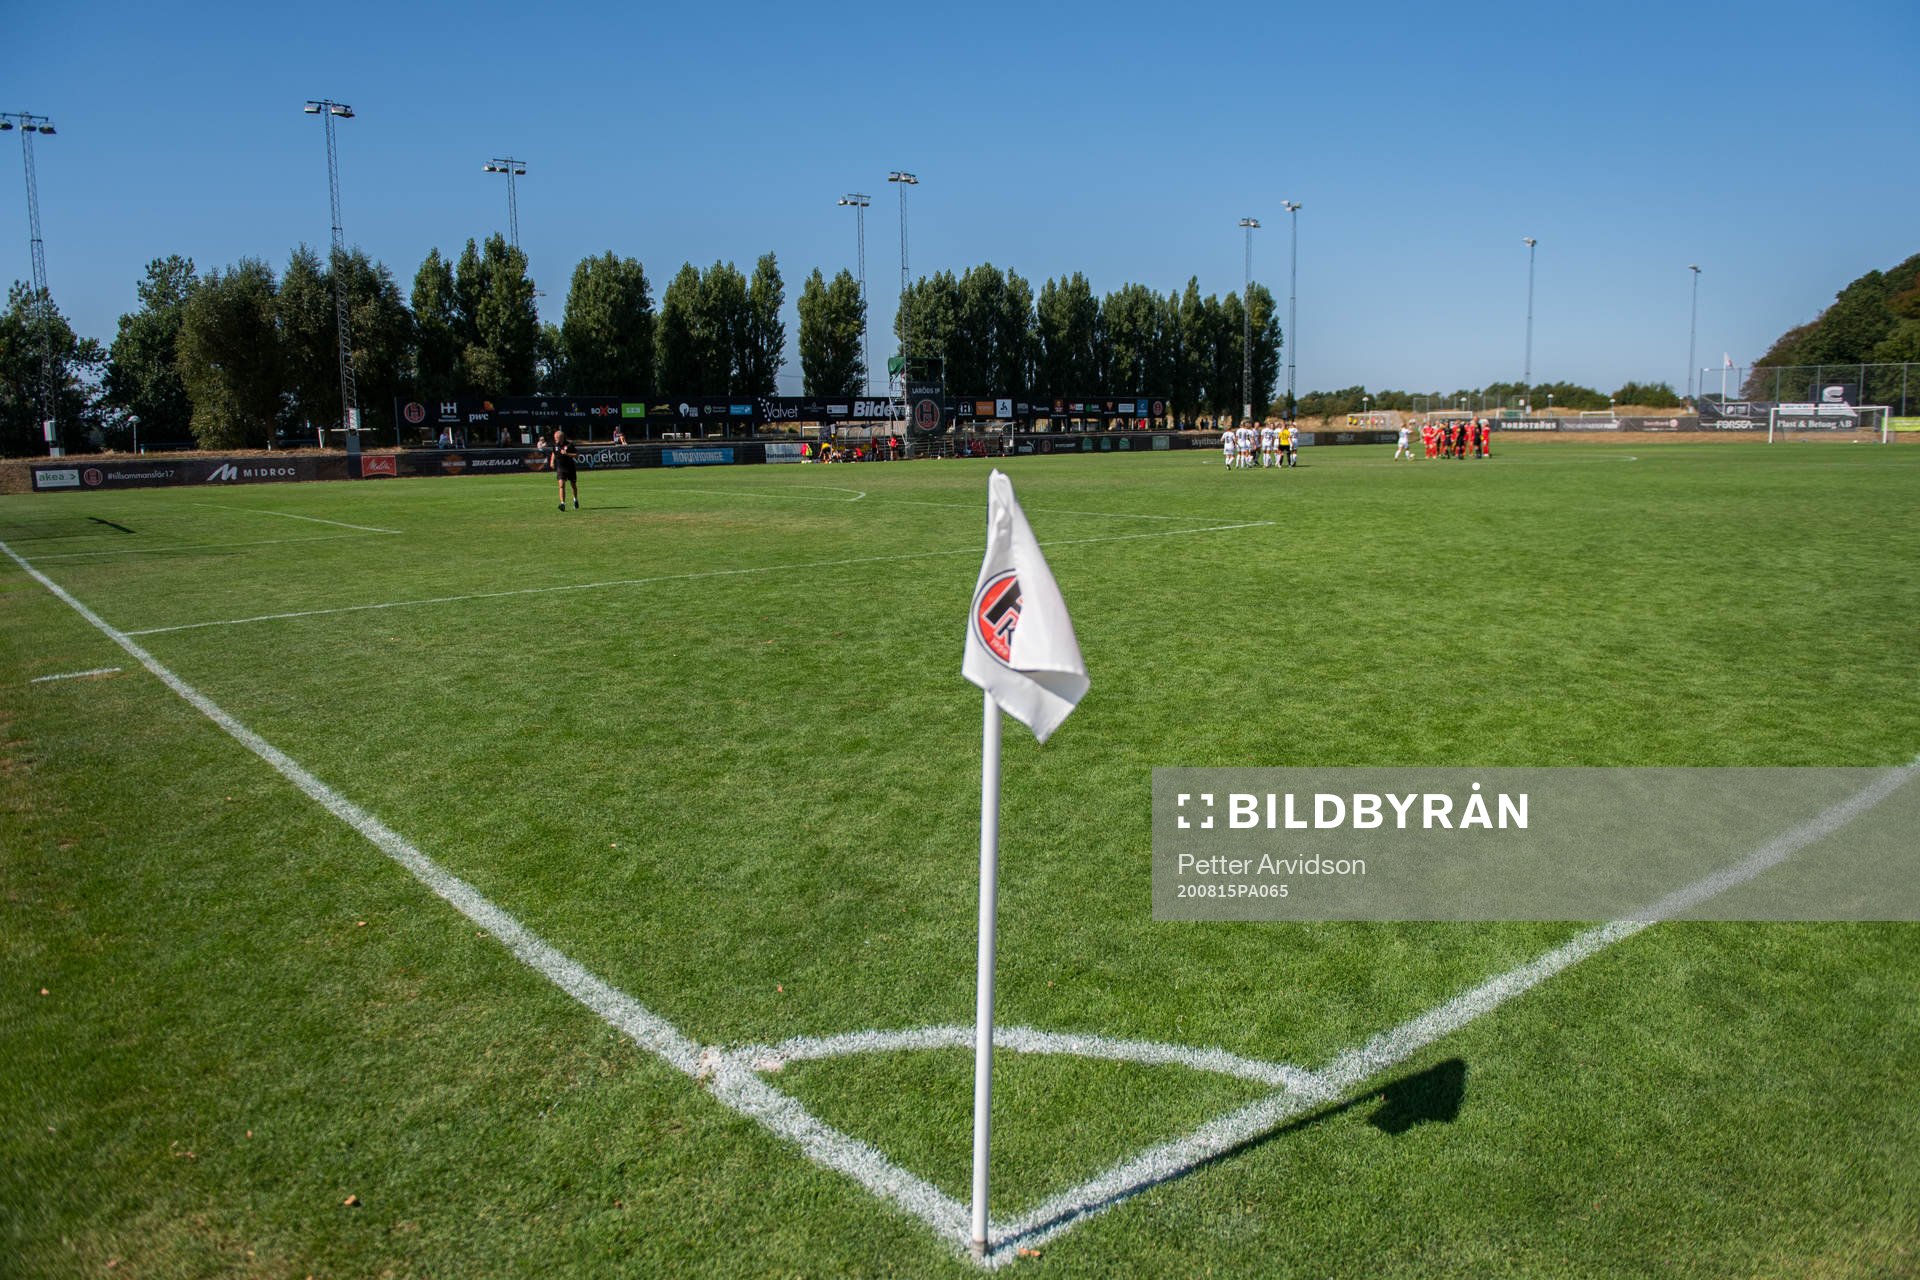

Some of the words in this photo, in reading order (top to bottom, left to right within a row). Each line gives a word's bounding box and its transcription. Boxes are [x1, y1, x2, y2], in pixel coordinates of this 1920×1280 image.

[766, 402, 798, 418] Valvet
[469, 413, 489, 423] pwc
[1838, 420, 1852, 428] AB
[472, 459, 520, 467] BIKEMAN
[39, 472, 64, 481] akea
[243, 467, 296, 477] MIDROC
